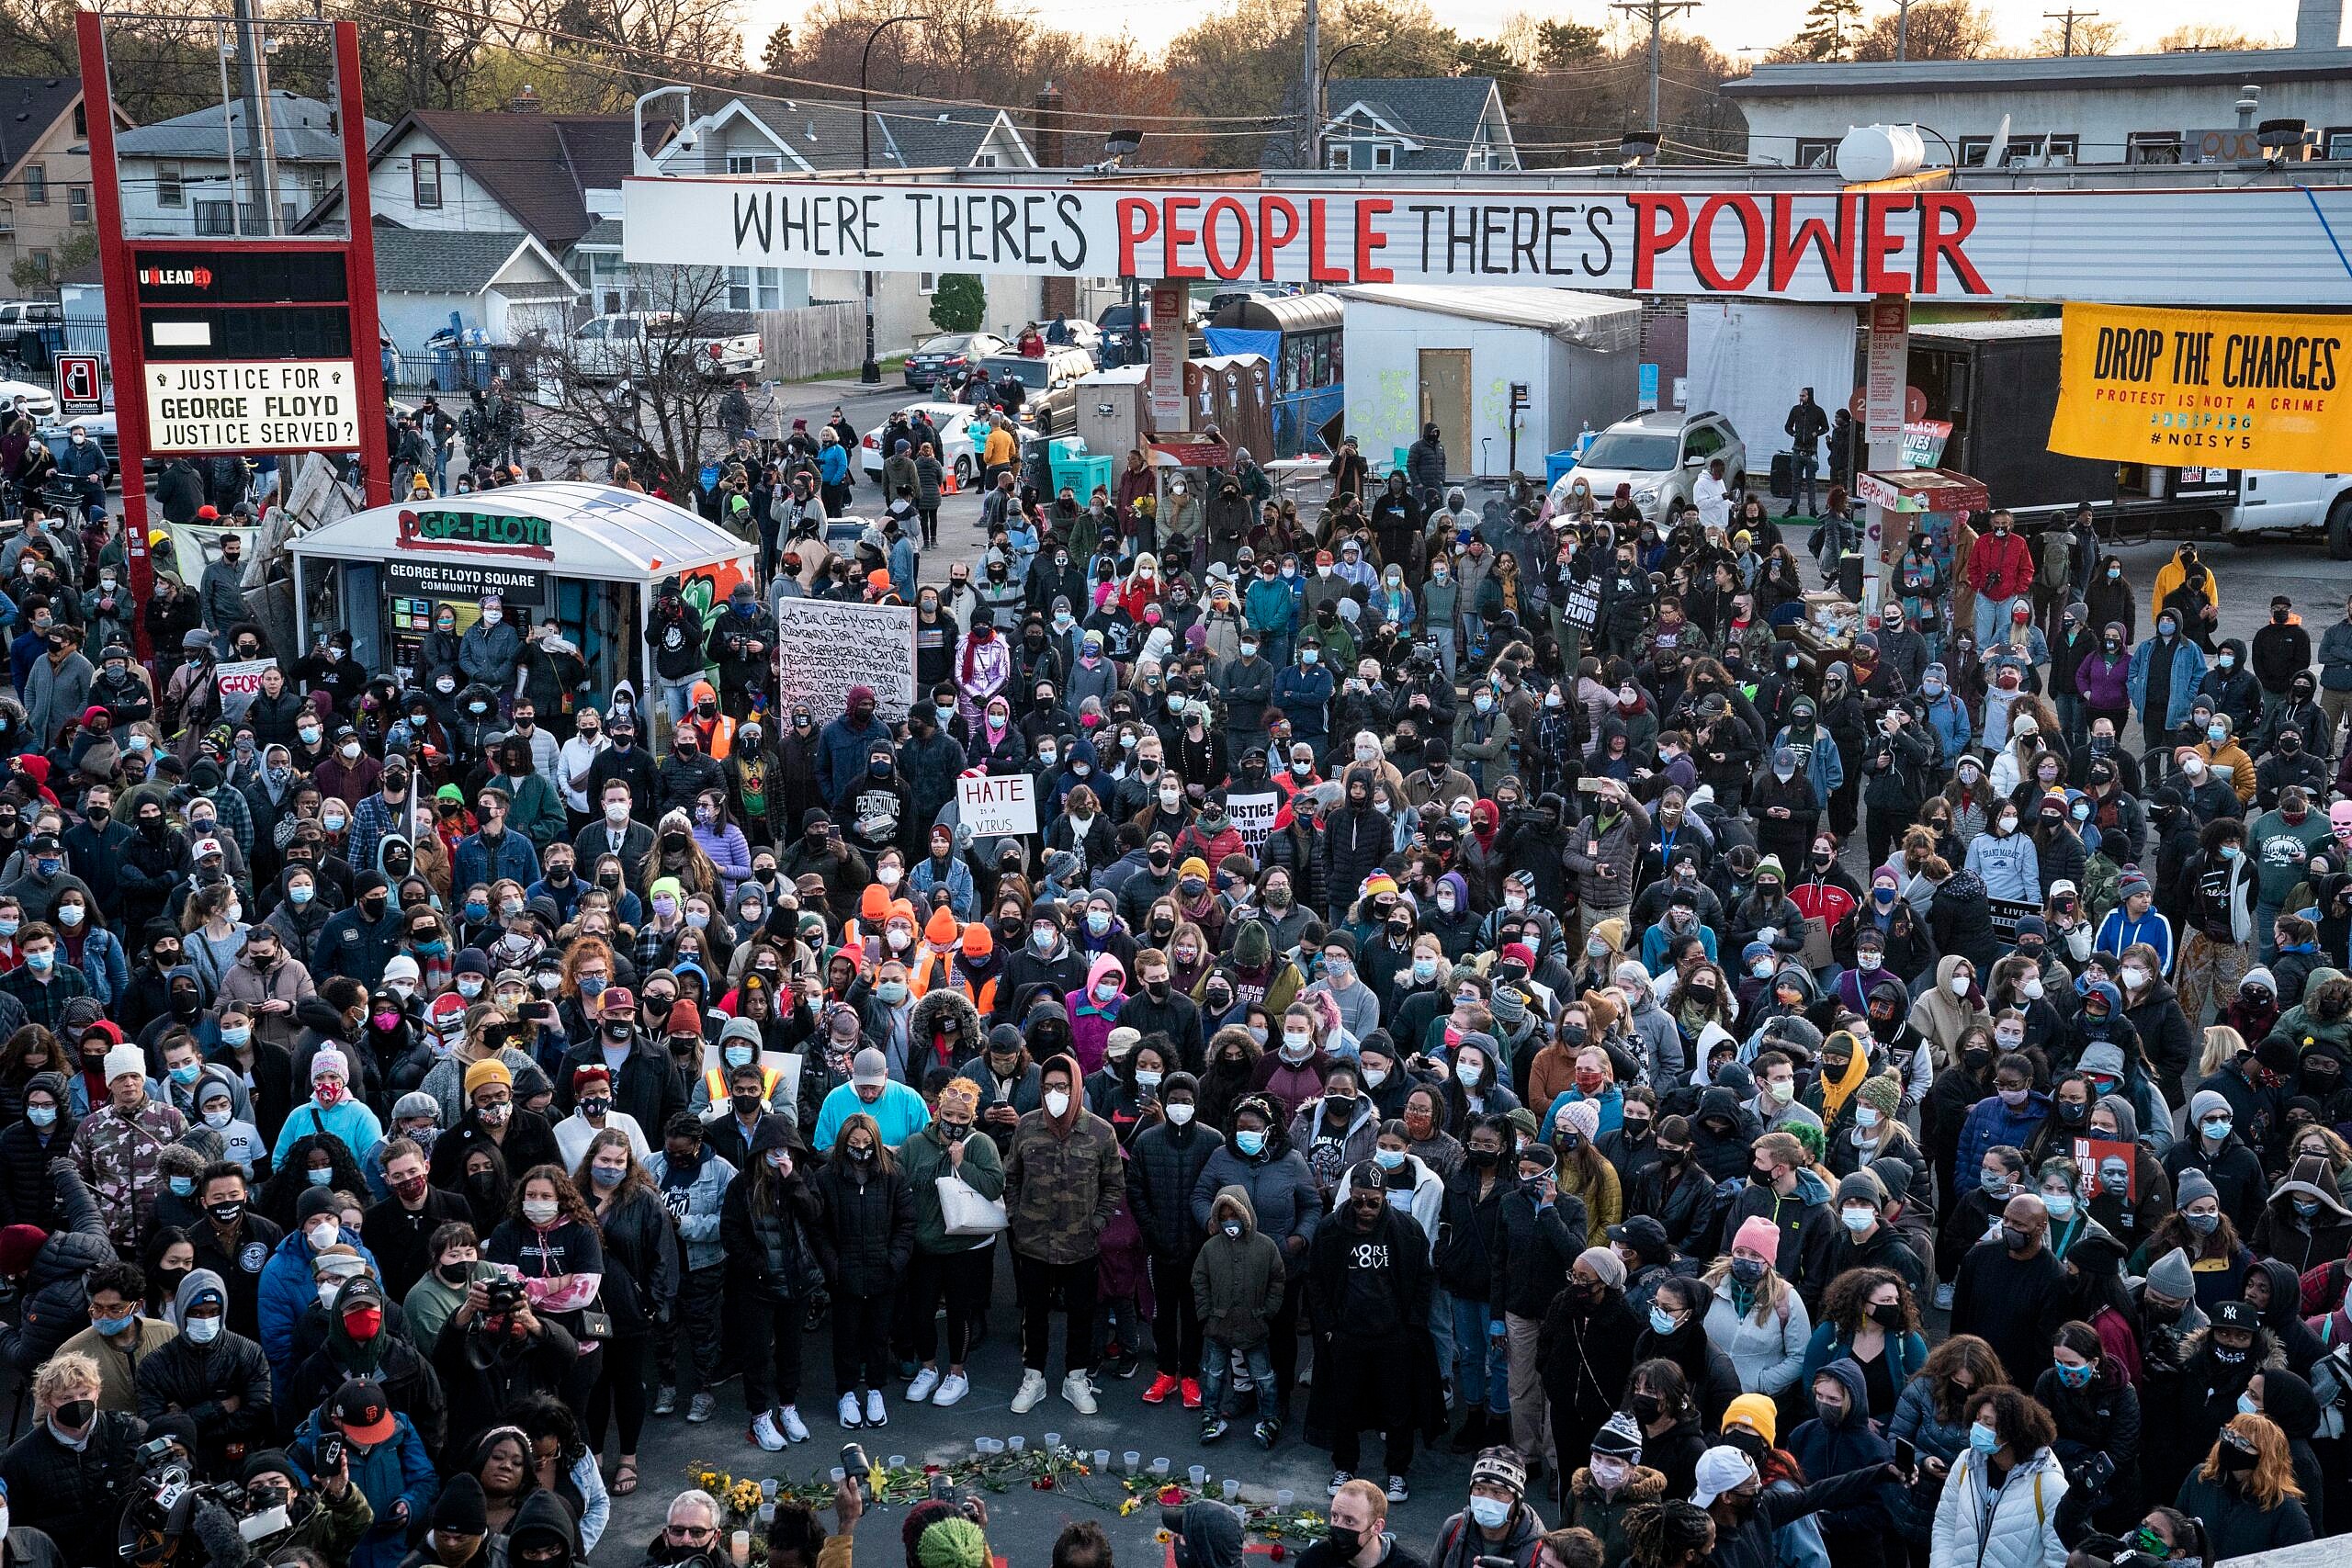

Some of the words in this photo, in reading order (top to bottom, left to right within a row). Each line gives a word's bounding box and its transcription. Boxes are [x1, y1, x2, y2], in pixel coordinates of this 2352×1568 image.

[733, 191, 885, 257] WHERE
[905, 191, 1087, 271] THERE'S
[1116, 195, 1395, 284] PEOPLE
[1408, 202, 1613, 276] THERE'S
[1625, 193, 1994, 295] POWER
[140, 269, 212, 286] UNLEADED
[1872, 342, 1901, 350] SERVE
[1873, 333, 1895, 342] SELF
[2094, 327, 2164, 383] DROP
[2172, 331, 2214, 386] THE
[2222, 333, 2340, 391] CHARGES
[177, 369, 270, 390] JUSTICE
[282, 368, 320, 389] FOR
[1188, 373, 1196, 386] 3
[161, 397, 247, 419] GEORGE
[265, 396, 338, 417] FLOYD
[1857, 398, 1866, 411] 2
[1910, 400, 1917, 412] 1
[2096, 389, 2165, 405] PROTEST
[2178, 394, 2194, 406] IS
[2204, 395, 2233, 410] NOT
[2246, 397, 2255, 410] A
[2270, 397, 2324, 412] CRIME
[163, 423, 250, 445] JUSTICE
[1903, 434, 1930, 450] LIVES
[390, 564, 438, 580] GEORGE
[442, 569, 481, 583] FLOYD
[485, 572, 536, 587] SQUARE
[421, 581, 479, 594] COMMUNITY
[481, 585, 504, 596] INFO
[1568, 592, 1599, 611] GEORGE
[1565, 604, 1596, 624] FLOYD
[966, 779, 1025, 805] HATE
[855, 795, 900, 817] PENGUINS
[1227, 803, 1274, 818] JUSTICE
[975, 818, 1012, 832] VIRUS
[2004, 908, 2030, 918] LIVES
[1248, 985, 1265, 996] BLAC
[2075, 1139, 2090, 1156] DO
[2075, 1156, 2096, 1175] YOU
[2081, 1175, 2095, 1191] EE
[2223, 1306, 2236, 1319] NY
